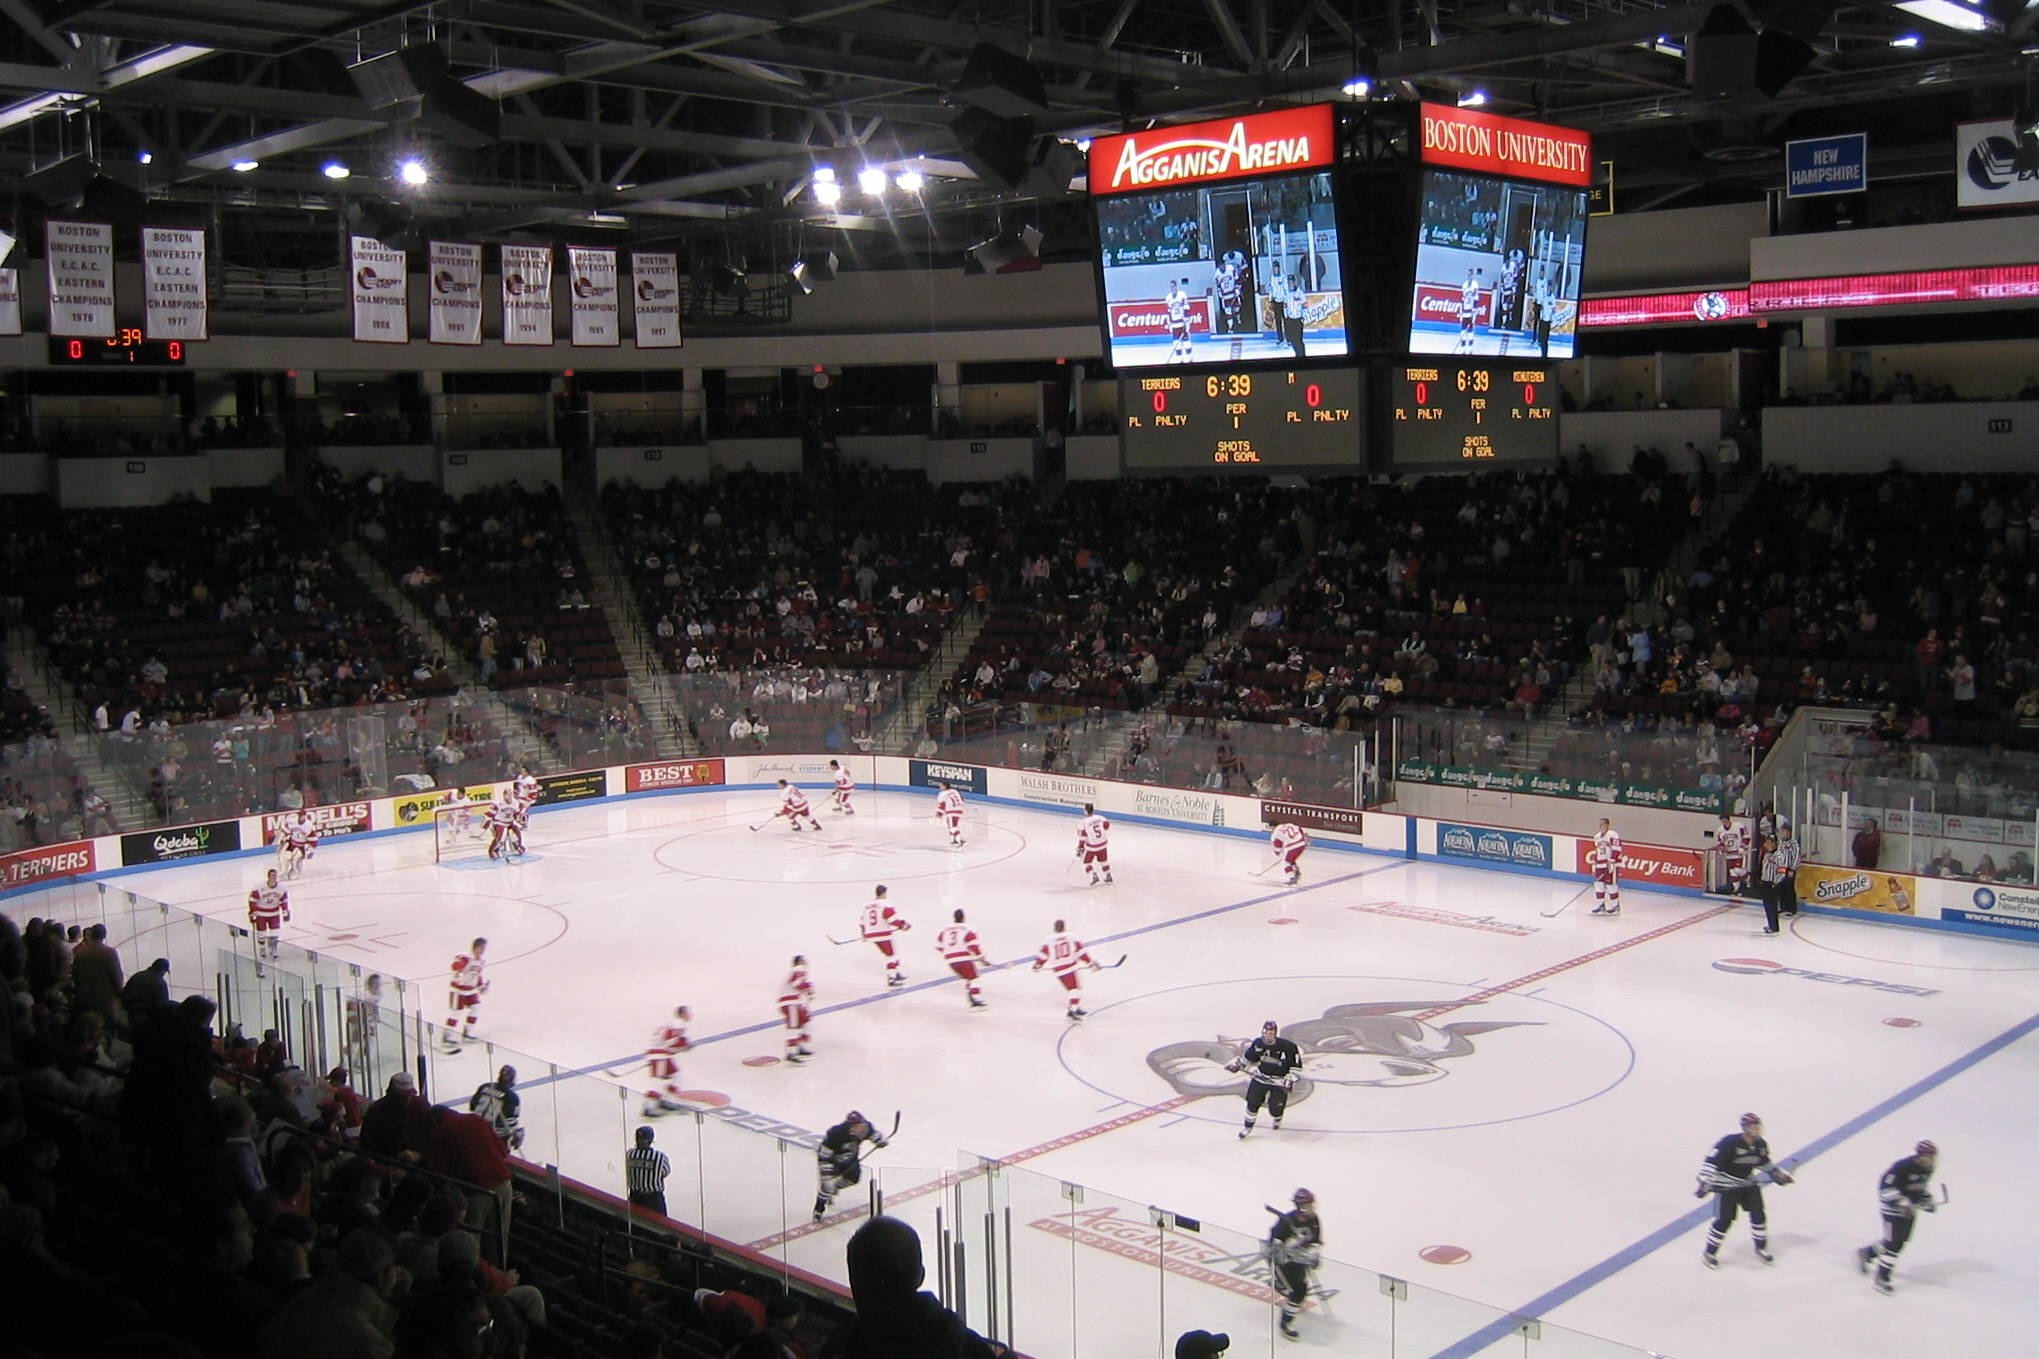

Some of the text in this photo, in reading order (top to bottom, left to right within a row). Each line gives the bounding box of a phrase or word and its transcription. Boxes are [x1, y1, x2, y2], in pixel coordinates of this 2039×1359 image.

[1424, 117, 1588, 172] BOSTON UNIVERSITY
[1111, 122, 1310, 188] AGGANIS ARENA
[1813, 148, 1839, 166] NEW
[1791, 164, 1861, 186] HAMPSHIRE
[58, 225, 100, 237] BOSTON
[153, 232, 192, 243] BOSTON
[50, 242, 111, 255] UNIVERSITY
[439, 246, 472, 256] BOSTON
[510, 249, 541, 258] BOSTON
[146, 250, 202, 261] UNIVERSITY
[354, 252, 403, 264] UNIVERSITY
[576, 253, 607, 262] BOSTON
[640, 256, 668, 265] BOSTON
[431, 257, 480, 267] UNIVERSITY
[570, 263, 616, 273] UNIVERSITY
[635, 266, 676, 275] UNIVERSITY
[58, 278, 105, 289] EASTERN
[154, 283, 198, 294] EASTERN
[52, 294, 112, 307] CHAMPIONS
[148, 299, 205, 310] CHAMPIONS
[356, 295, 405, 306] CHAMPIONS
[432, 298, 480, 308] CHAMPIONS
[505, 302, 549, 311] CHAMPIONS
[573, 303, 617, 312] CHAMPIONS
[637, 305, 680, 314] CHAMPIONS
[70, 340, 181, 359] 0 0
[1141, 378, 1181, 390] TERRIERS
[1206, 375, 1251, 397] 6:39
[1406, 369, 1438, 381] TERRIERS
[1457, 370, 1489, 391] 6:39
[1153, 384, 1320, 412] 0 0
[1416, 382, 1534, 404] 0 0
[1226, 404, 1246, 414] PER
[1471, 399, 1487, 409] PER
[1287, 410, 1349, 422] PL PNLTY
[1396, 408, 1442, 420] PL PNLTY
[1512, 408, 1552, 418] PL PNLTY
[1128, 415, 1187, 427] PL PNLTY
[1234, 417, 1239, 429] 1
[1217, 441, 1250, 451] SHOTS
[1464, 436, 1488, 447] SHOTS
[1215, 451, 1260, 462] ON GOAL
[1462, 447, 1495, 457] ON GOAL
[639, 765, 694, 783] BEST
[927, 764, 973, 782] KEYSPAN
[1020, 775, 1097, 796] WALSH BROTHERS
[1136, 790, 1170, 806] Barnes
[1182, 796, 1210, 811] Noble
[1264, 804, 1359, 823] CRYSTAL TRANSPORT
[1093, 825, 1102, 839] 5
[153, 833, 200, 856] Qdoba
[11, 850, 89, 882] TERRIERS
[1661, 862, 1696, 878] Bank
[1817, 873, 1869, 898] Snapple
[869, 909, 878, 926] 9
[949, 931, 958, 947] 3
[1054, 941, 1071, 960] 10
[1768, 966, 1943, 996] PEPSI
[1051, 1206, 1216, 1264] AGGANIS
